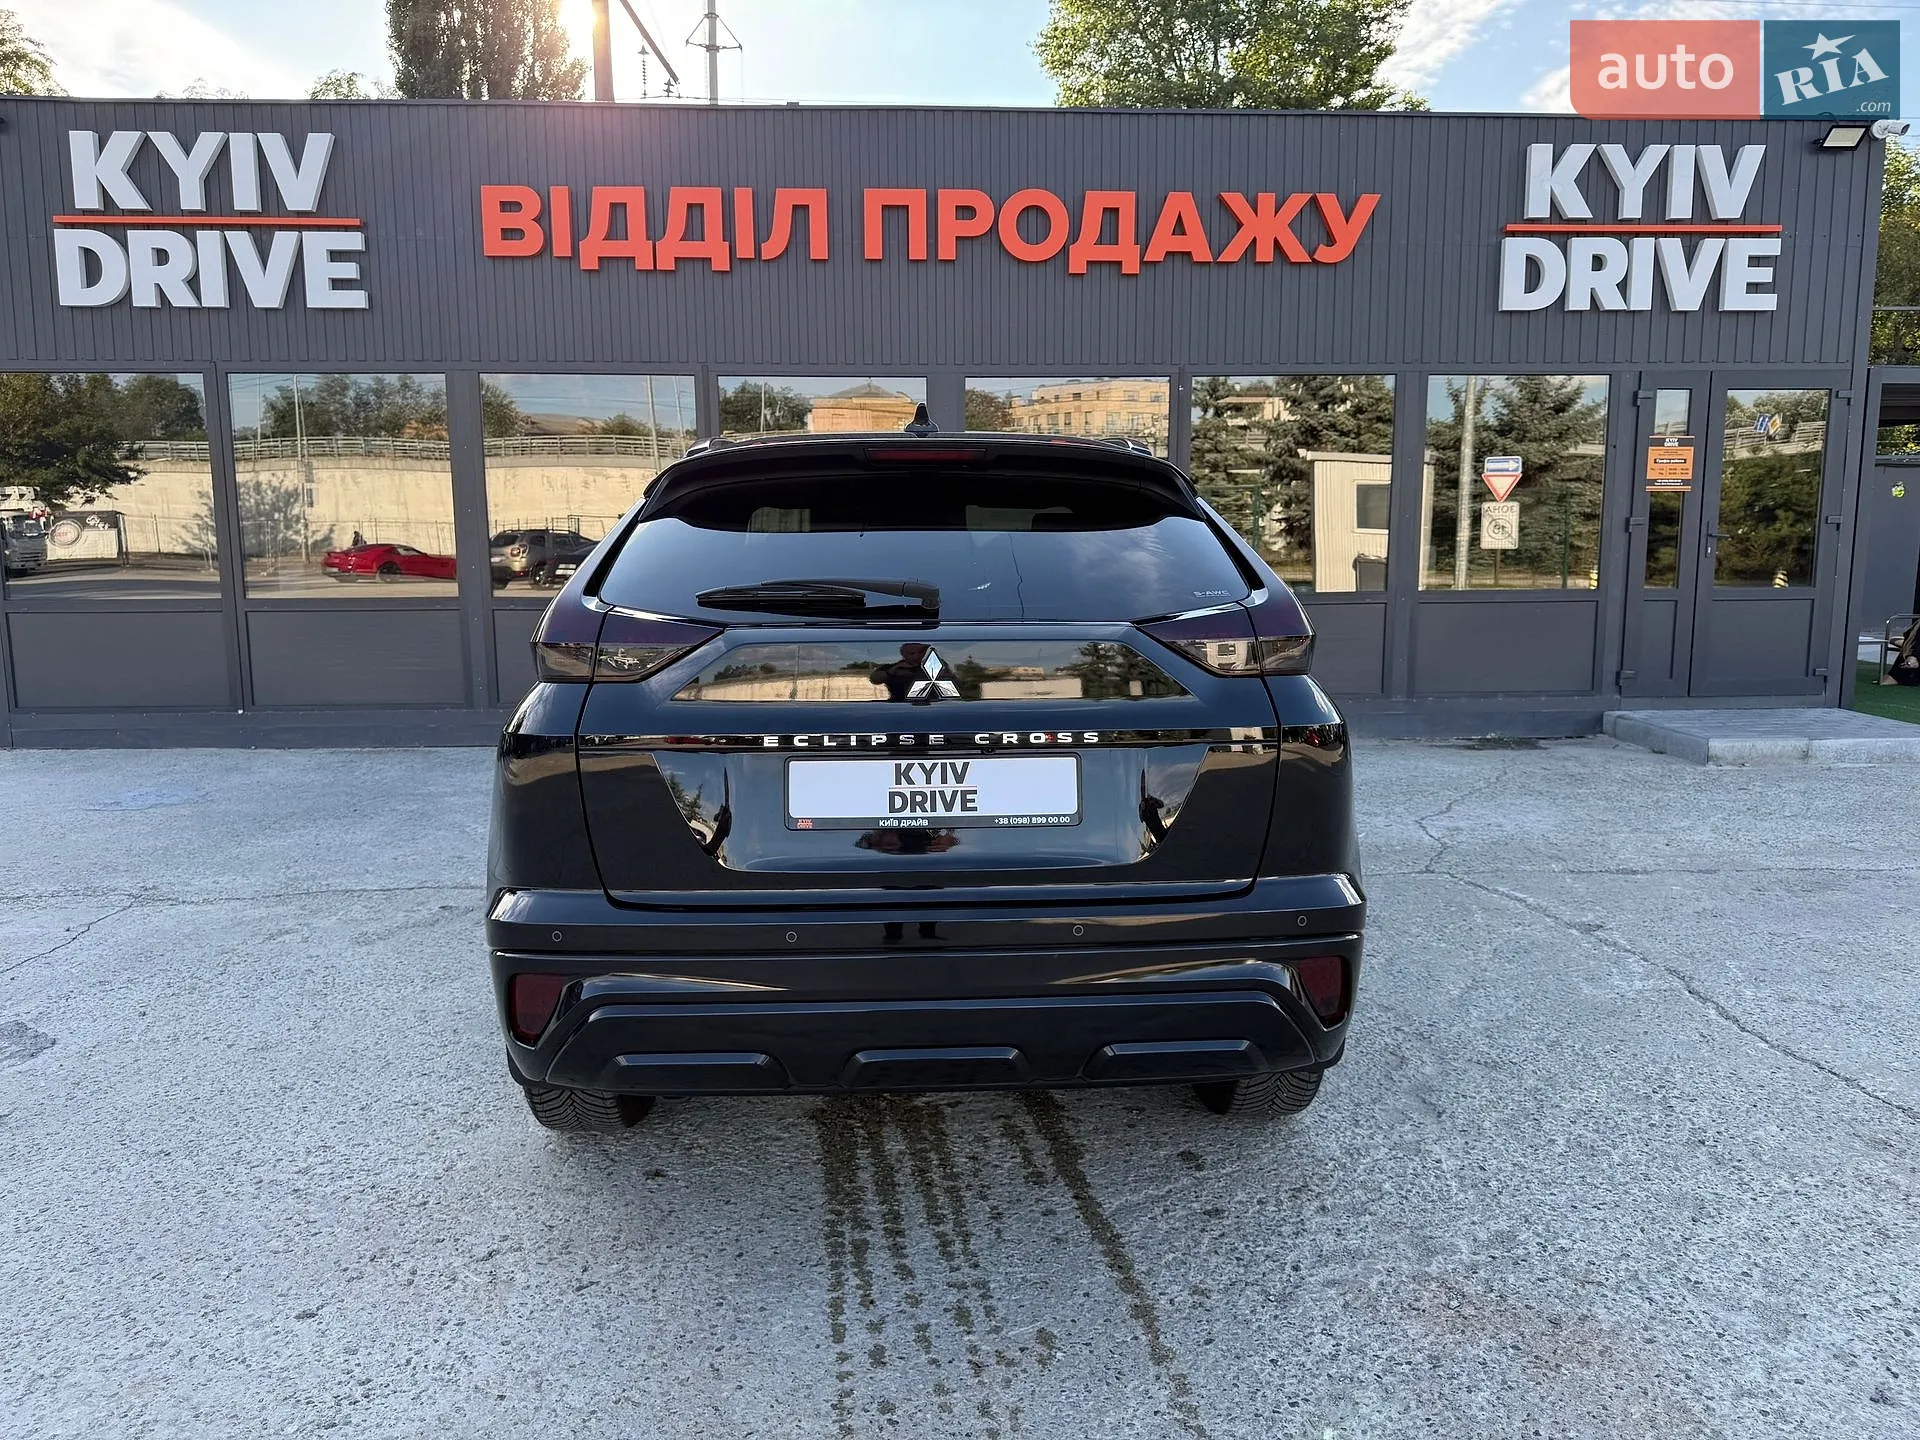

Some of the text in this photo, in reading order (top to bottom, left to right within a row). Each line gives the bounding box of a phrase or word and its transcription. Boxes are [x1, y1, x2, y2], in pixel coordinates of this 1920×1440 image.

[68, 130, 336, 212] KYIV
[1524, 144, 1767, 220] KYIV
[480, 185, 1382, 275] ВІДДІЛ ПРОДАЖУ
[53, 228, 370, 310] DRIVE
[1498, 237, 1782, 312] DRIVE
[763, 732, 1101, 747] ECLIPSE CROSS
[893, 761, 971, 786] KYIV
[879, 818, 929, 828] КИЇВ ДРАЙВ
[888, 789, 979, 814] DRIVE
[994, 815, 1070, 825] +38 (098) 899 00 00
